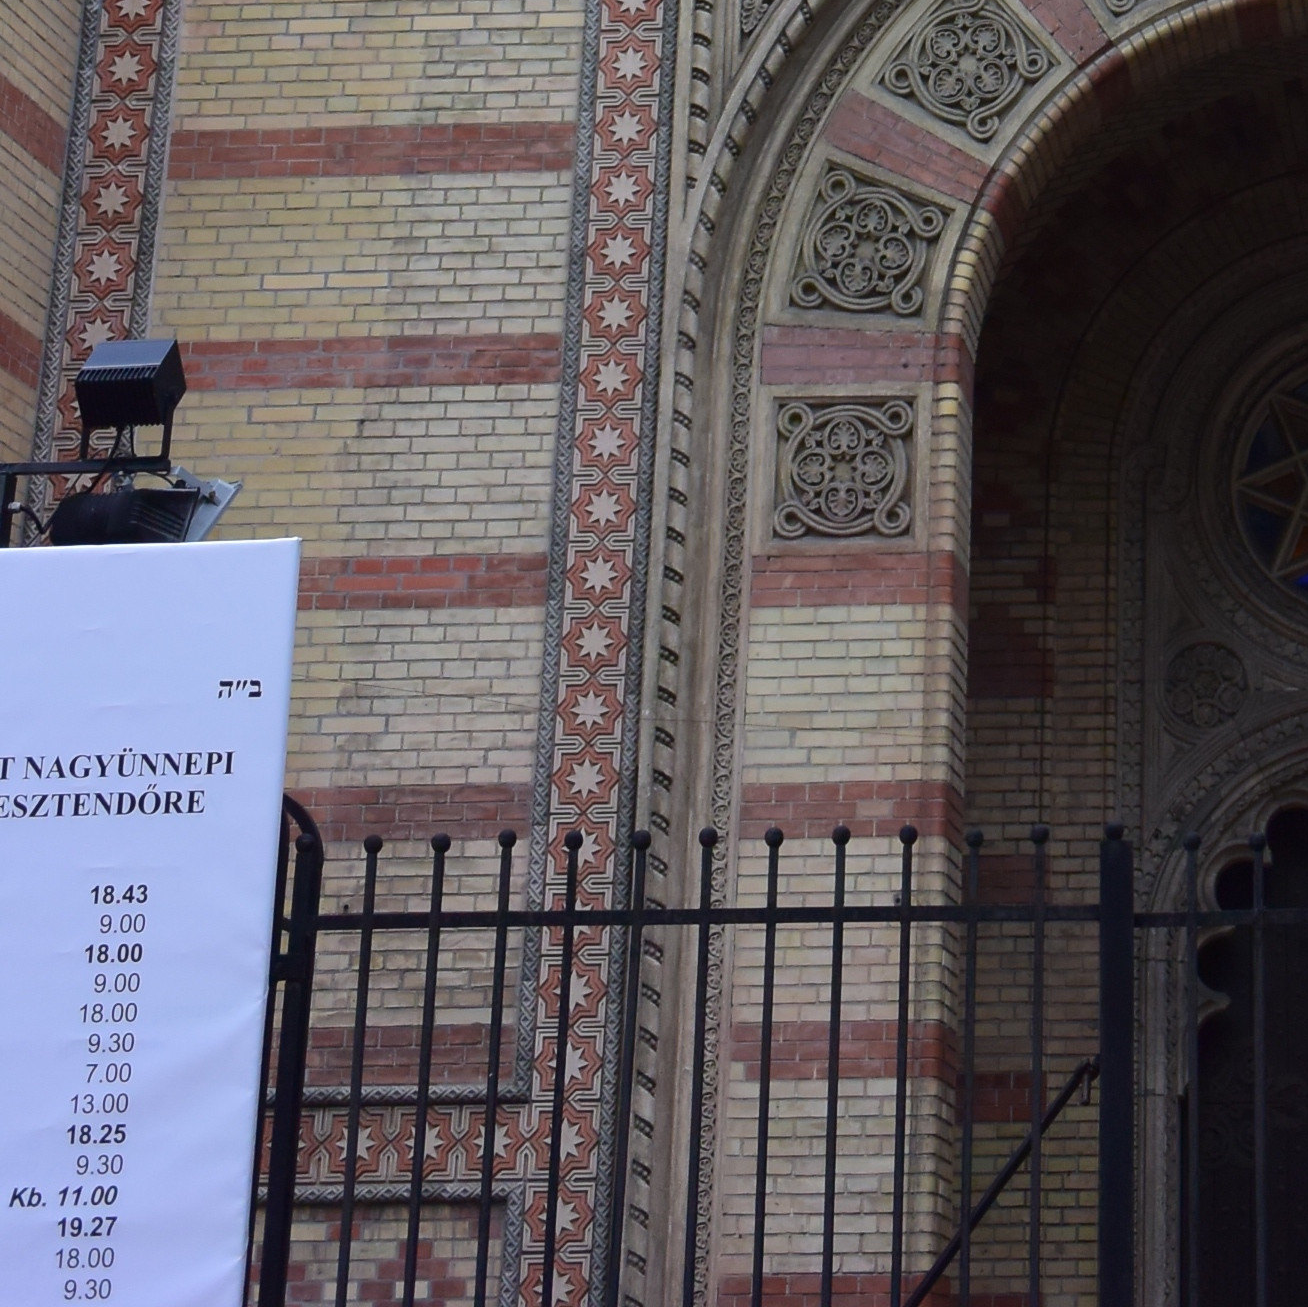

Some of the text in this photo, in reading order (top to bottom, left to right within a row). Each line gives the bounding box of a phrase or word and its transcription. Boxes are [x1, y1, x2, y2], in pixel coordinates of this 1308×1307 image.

[22, 748, 236, 780] NAGYÜNNEPI
[91, 884, 148, 905] 18.43
[99, 913, 146, 934] 9.00
[84, 943, 143, 964] 18.00
[93, 972, 141, 994] 9.00
[79, 1002, 138, 1023] 18.00
[88, 1032, 135, 1054] 9.30
[85, 1062, 132, 1084] 7.00
[70, 1092, 129, 1114] 13.00
[66, 1123, 127, 1145] 18.25
[76, 1153, 124, 1176] 9.30
[8, 1184, 118, 1208] Kb. 11.00
[57, 1216, 118, 1238] 19.27
[55, 1247, 115, 1269] 18.00
[63, 1278, 112, 1301] 9.30
